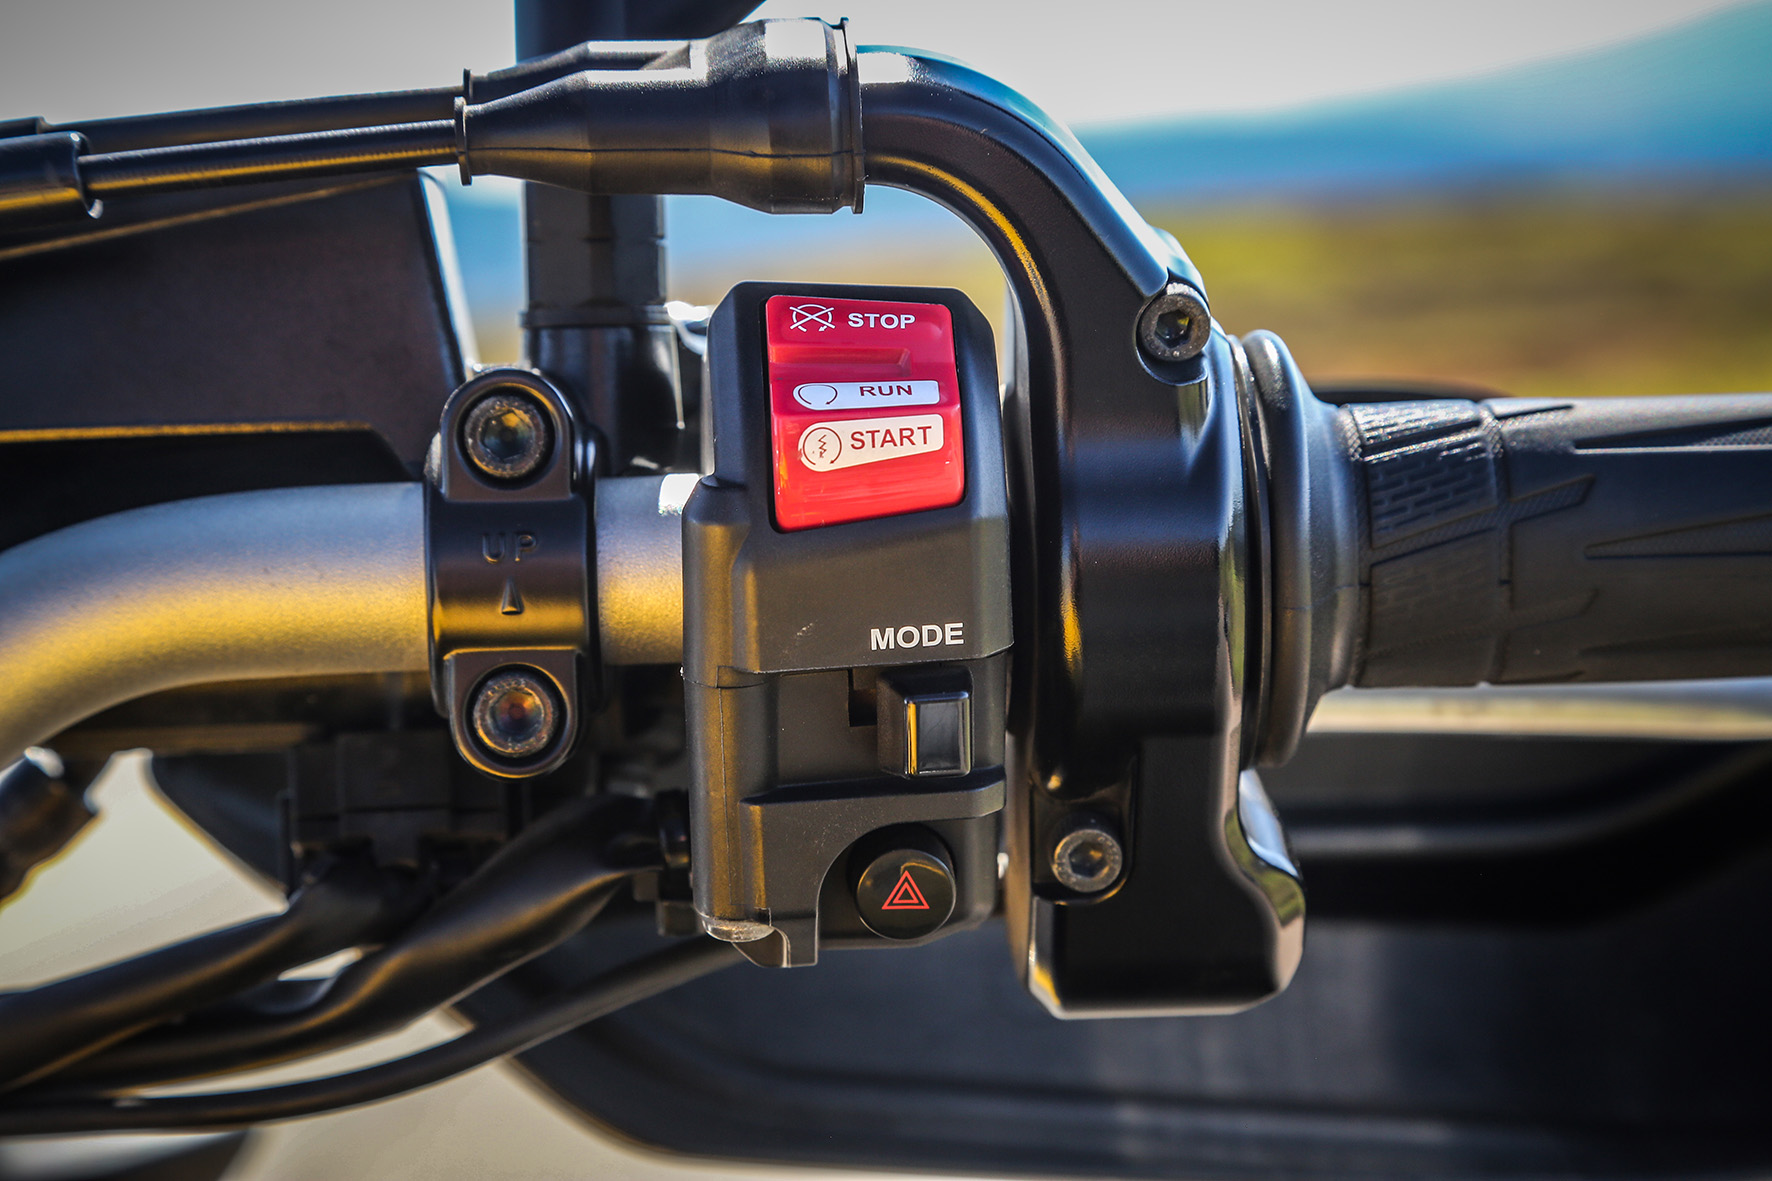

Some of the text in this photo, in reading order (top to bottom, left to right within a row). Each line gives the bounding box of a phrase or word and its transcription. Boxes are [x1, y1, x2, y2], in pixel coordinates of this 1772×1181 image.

[847, 312, 916, 330] STOP
[859, 384, 913, 397] RUN
[850, 425, 932, 450] START
[481, 533, 539, 564] UP
[870, 622, 965, 650] MODE
